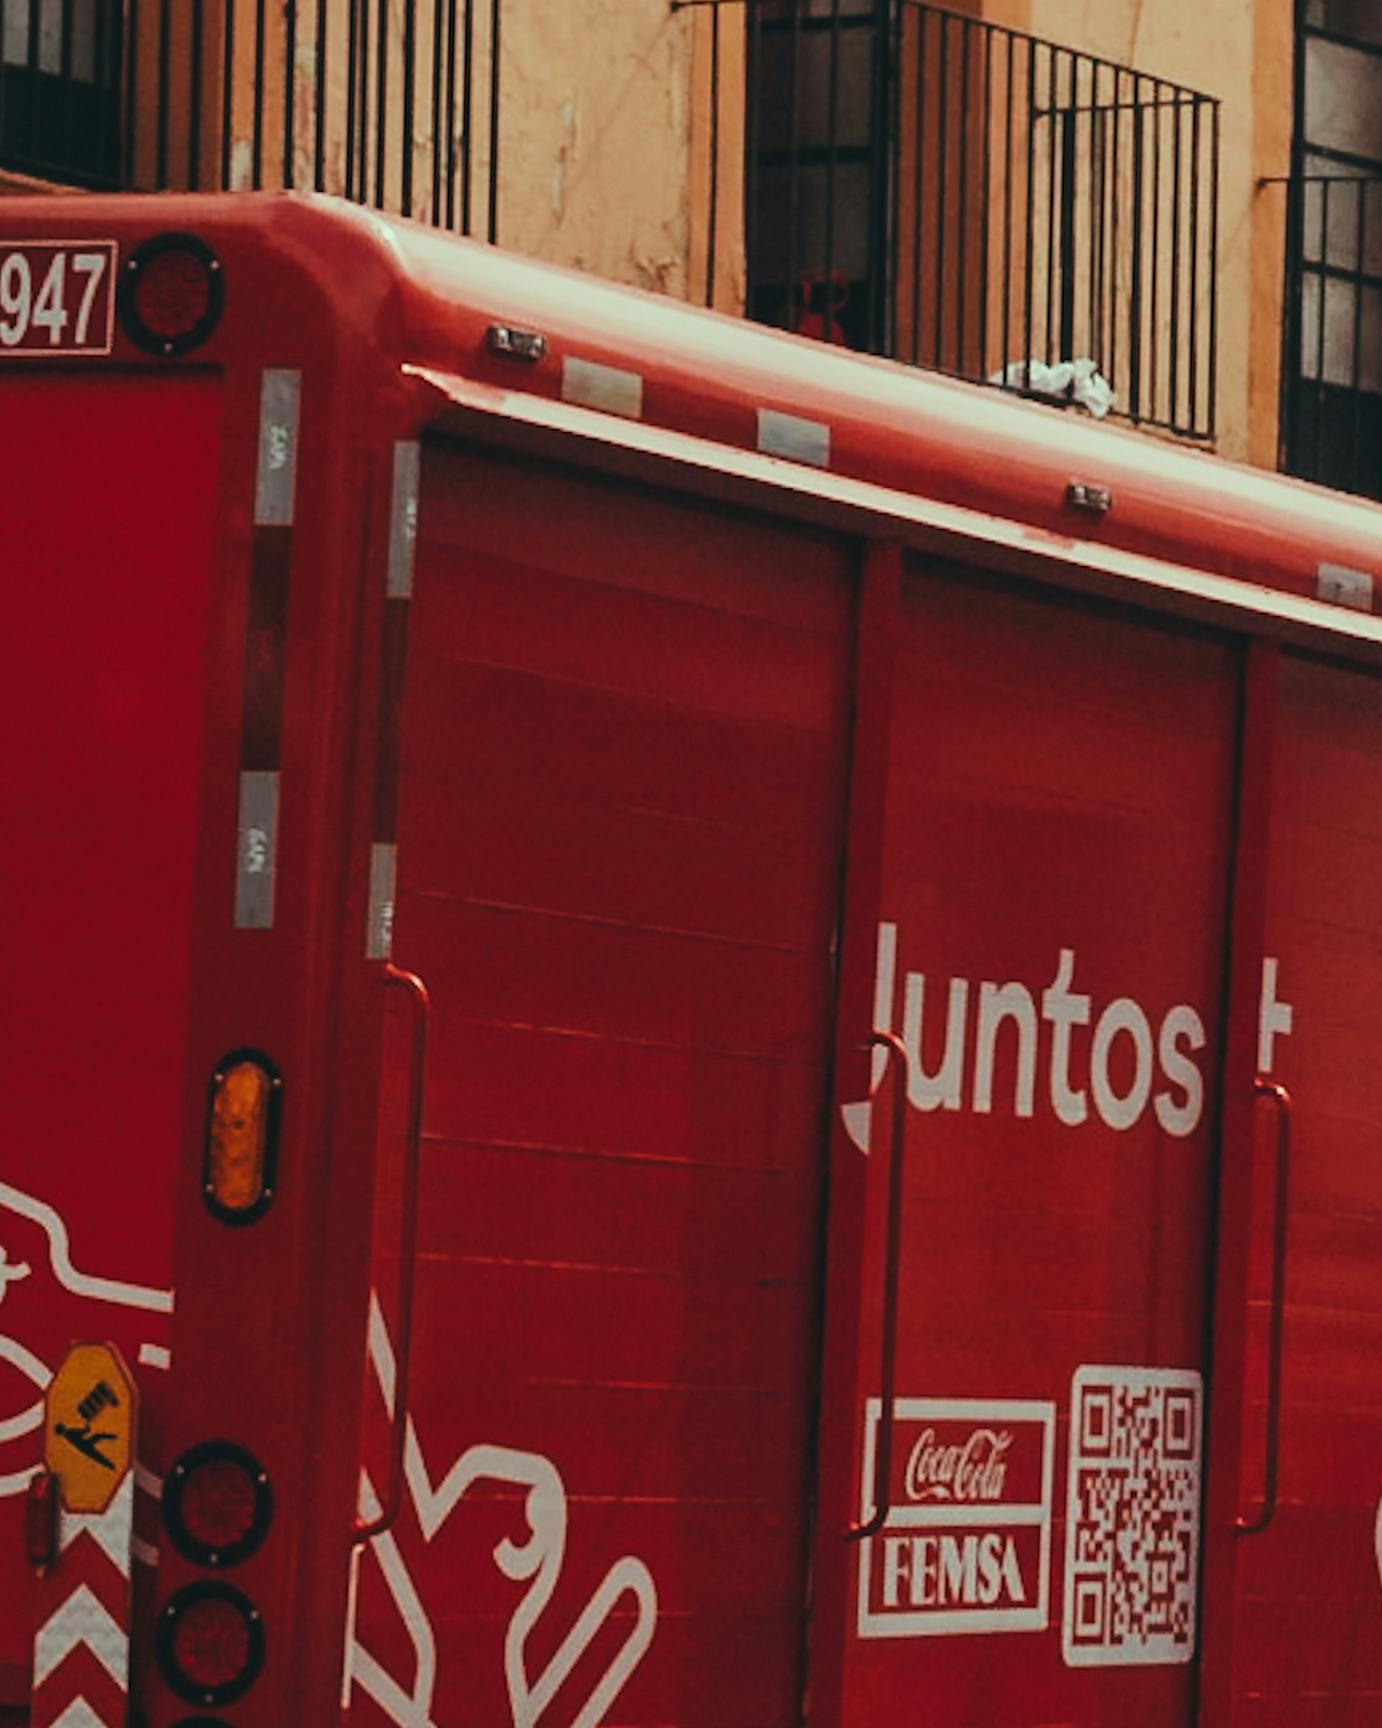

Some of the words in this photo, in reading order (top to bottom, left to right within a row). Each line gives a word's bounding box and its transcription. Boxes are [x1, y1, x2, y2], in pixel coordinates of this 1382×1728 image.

[0, 252, 106, 346] 947
[841, 921, 1206, 1155] Juntos
[905, 1427, 1013, 1501] Coca-Cola
[883, 1533, 1025, 1606] FEMSA
